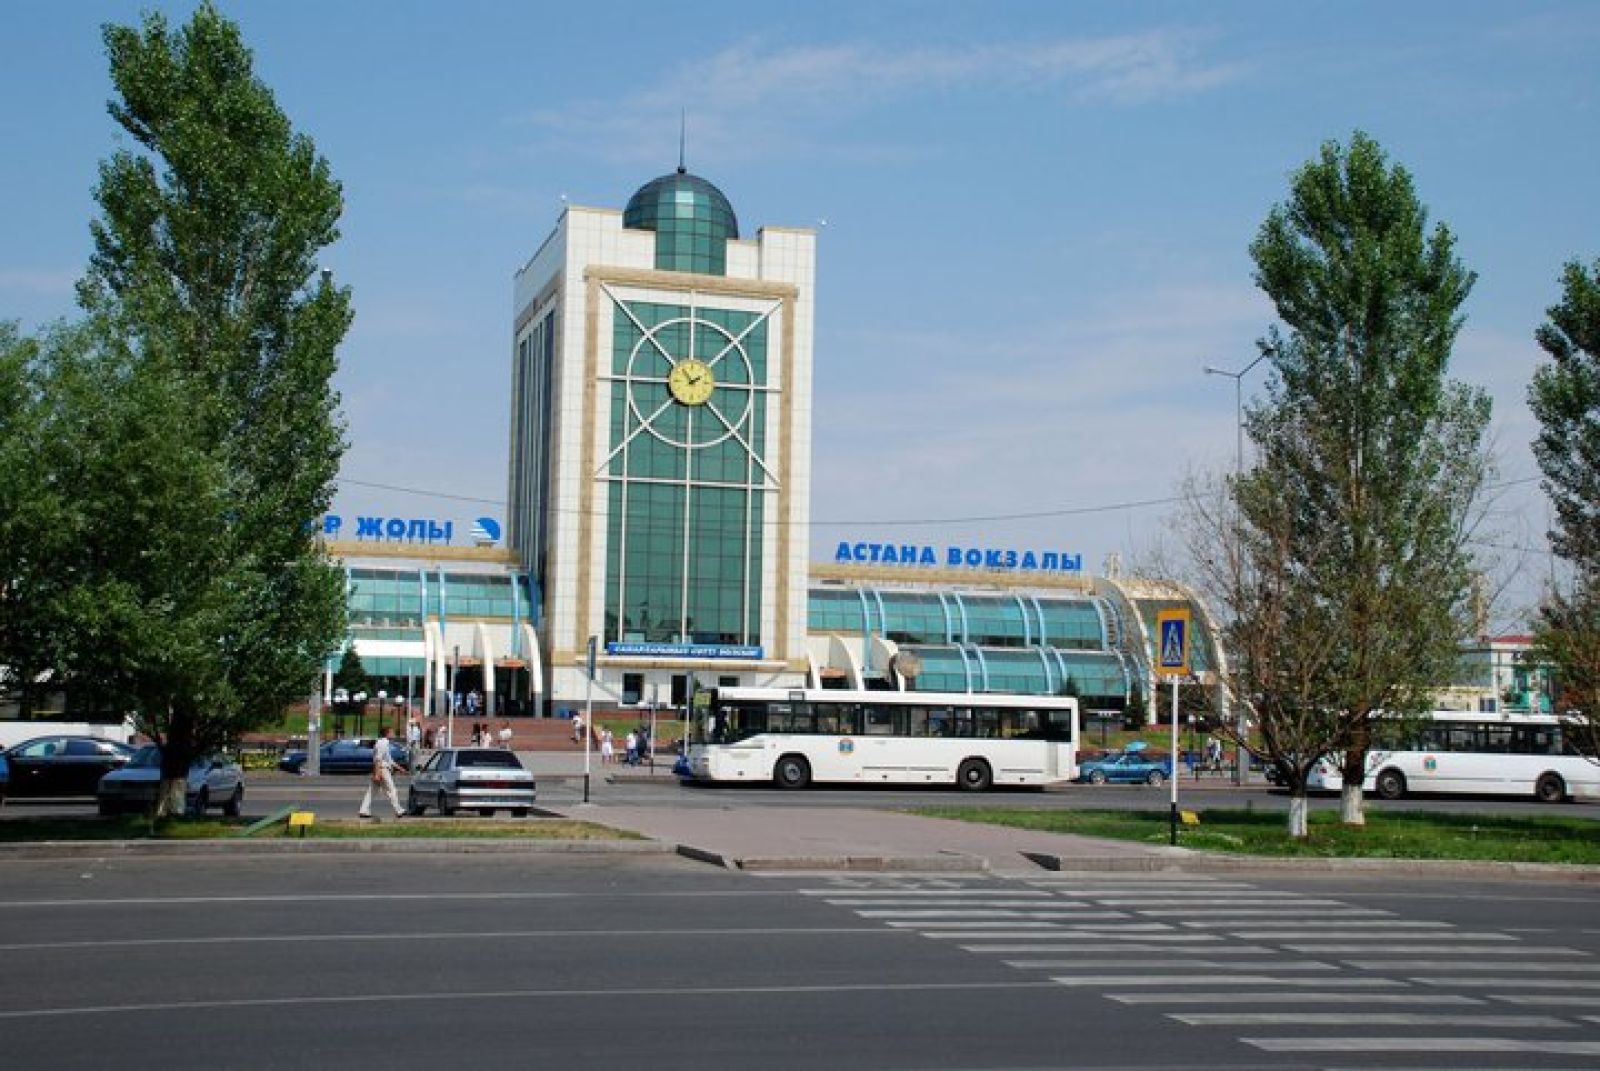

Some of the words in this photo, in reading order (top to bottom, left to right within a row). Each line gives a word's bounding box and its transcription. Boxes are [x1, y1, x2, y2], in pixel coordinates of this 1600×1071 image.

[355, 516, 454, 540] ЖОЛЫ
[835, 541, 937, 565] АСТАНА
[946, 546, 1083, 572] ВОКЗАЛЫ
